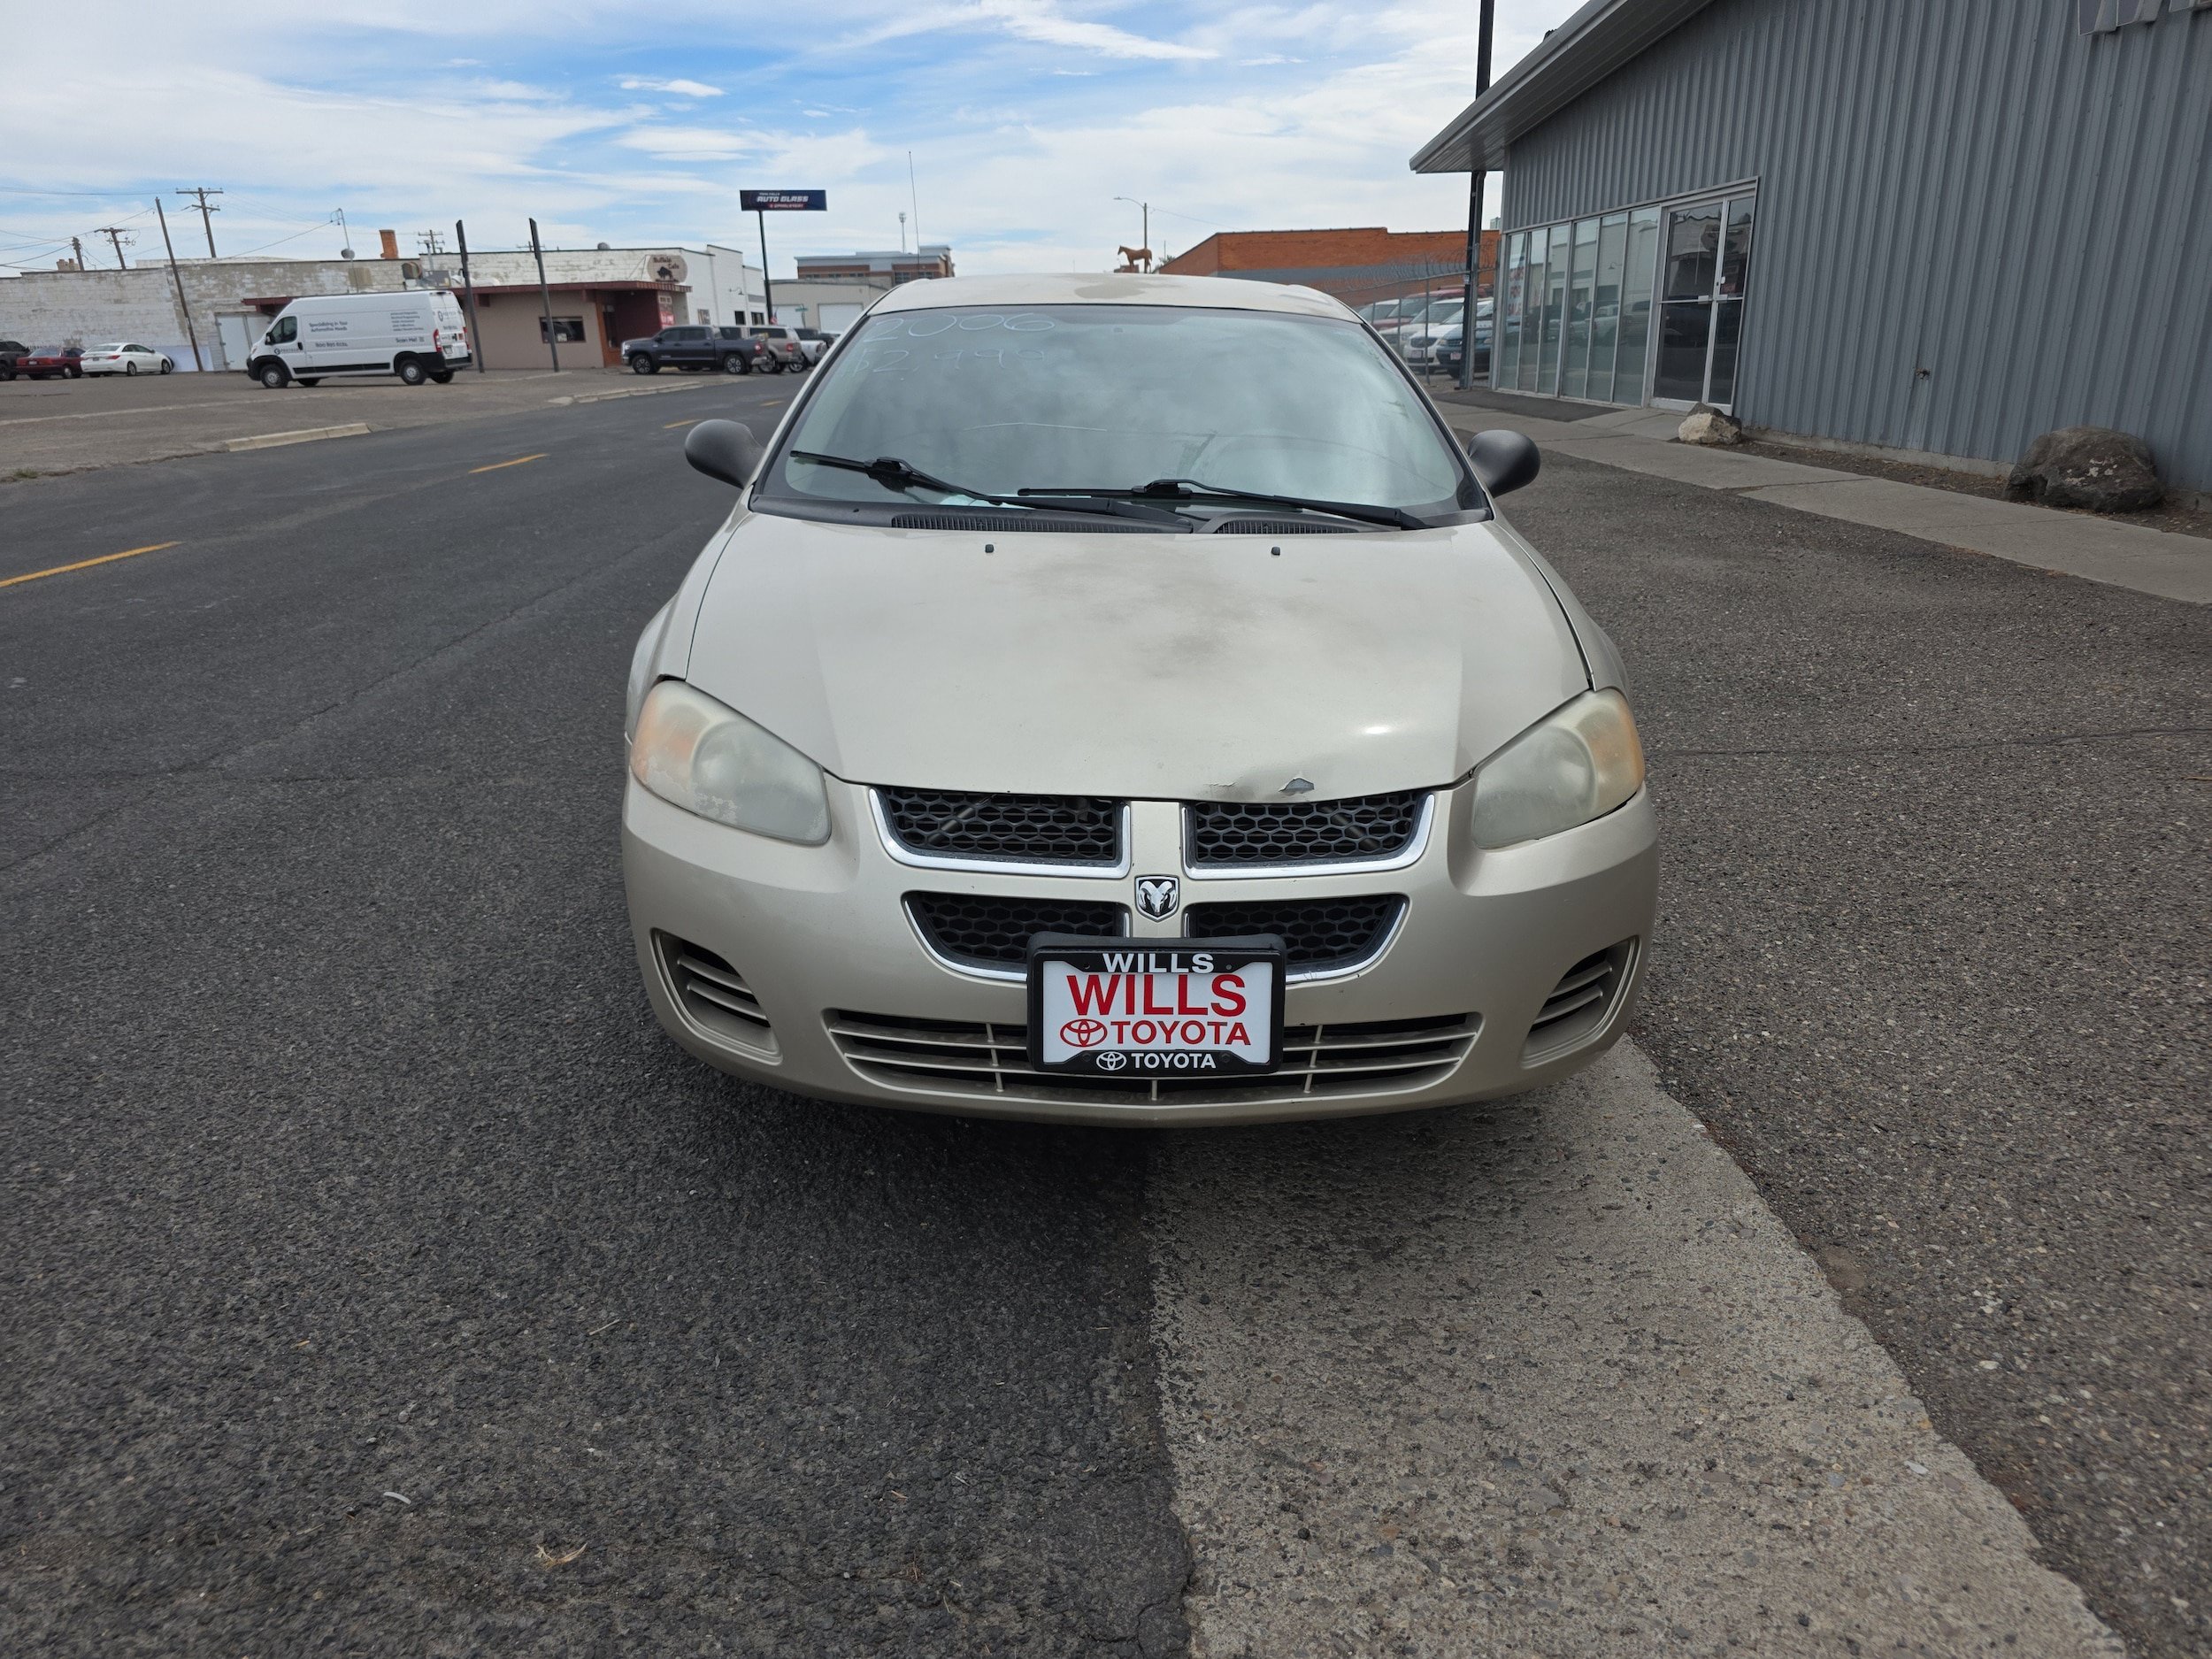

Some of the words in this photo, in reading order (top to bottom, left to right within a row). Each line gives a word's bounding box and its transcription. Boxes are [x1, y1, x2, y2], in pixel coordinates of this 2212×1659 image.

[864, 313, 1056, 342] 2006
[1102, 953, 1215, 974] WILLS
[1066, 974, 1247, 1017] WILLS
[1110, 1020, 1251, 1046] TOYOTA
[1131, 1053, 1217, 1069] TOYOTA
